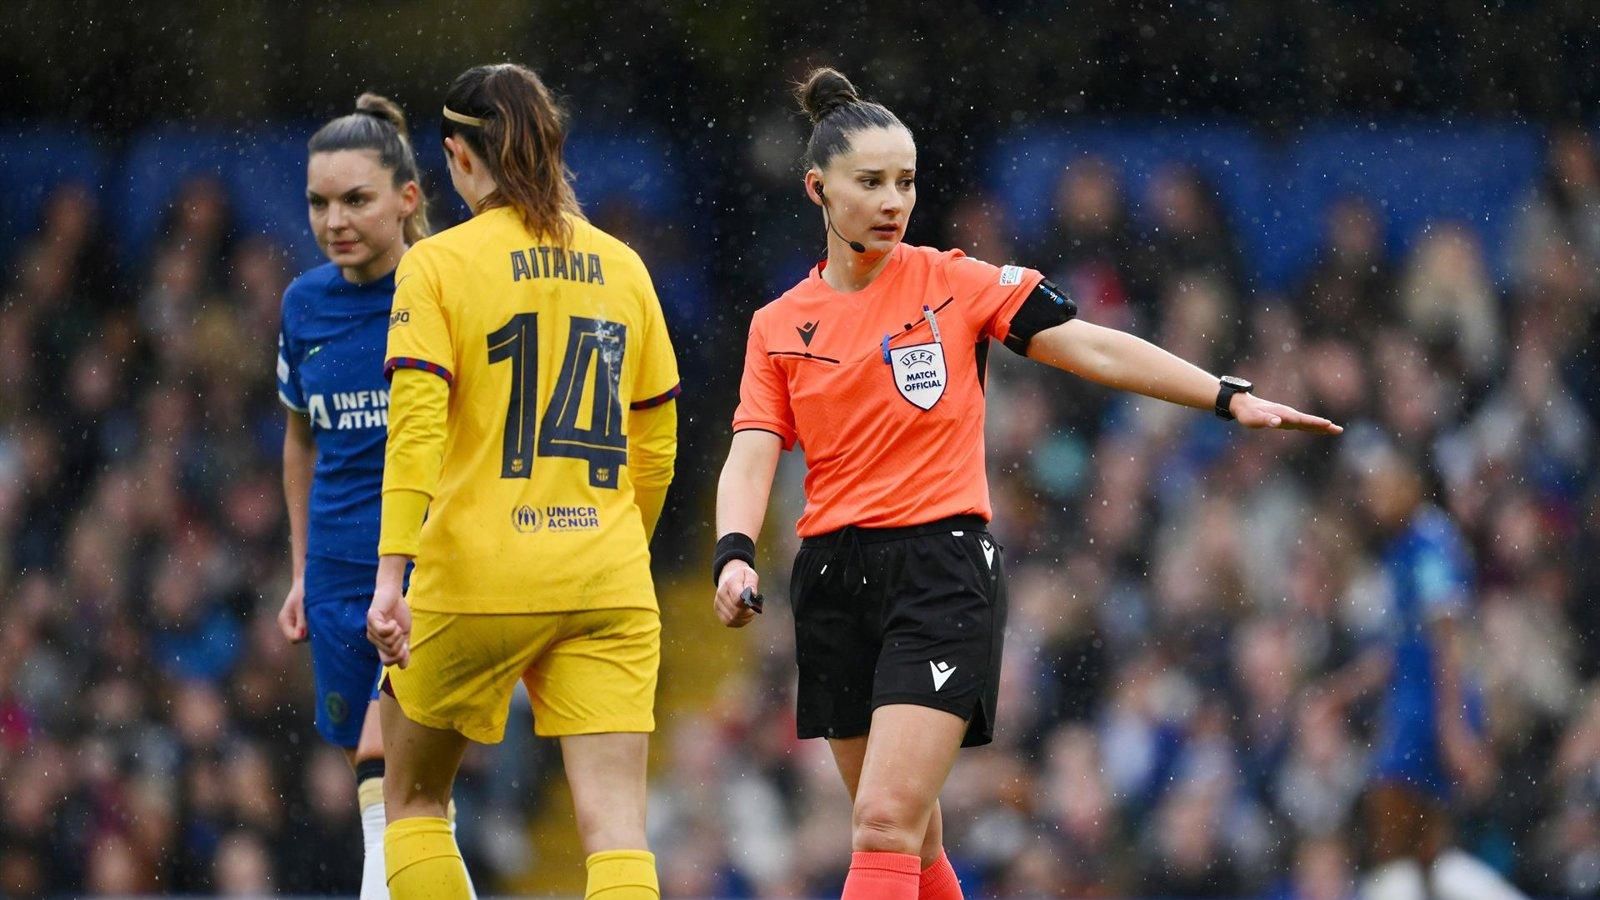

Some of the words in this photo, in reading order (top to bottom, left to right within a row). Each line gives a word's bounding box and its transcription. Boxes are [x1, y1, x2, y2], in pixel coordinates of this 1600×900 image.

[510, 246, 605, 285] AITANA
[902, 352, 933, 366] UEFA
[906, 370, 937, 382] MATCH
[904, 380, 942, 392] OFFICIAL
[487, 312, 627, 489] 14
[546, 506, 598, 517] UNHCR
[548, 518, 599, 528] ACNUR
